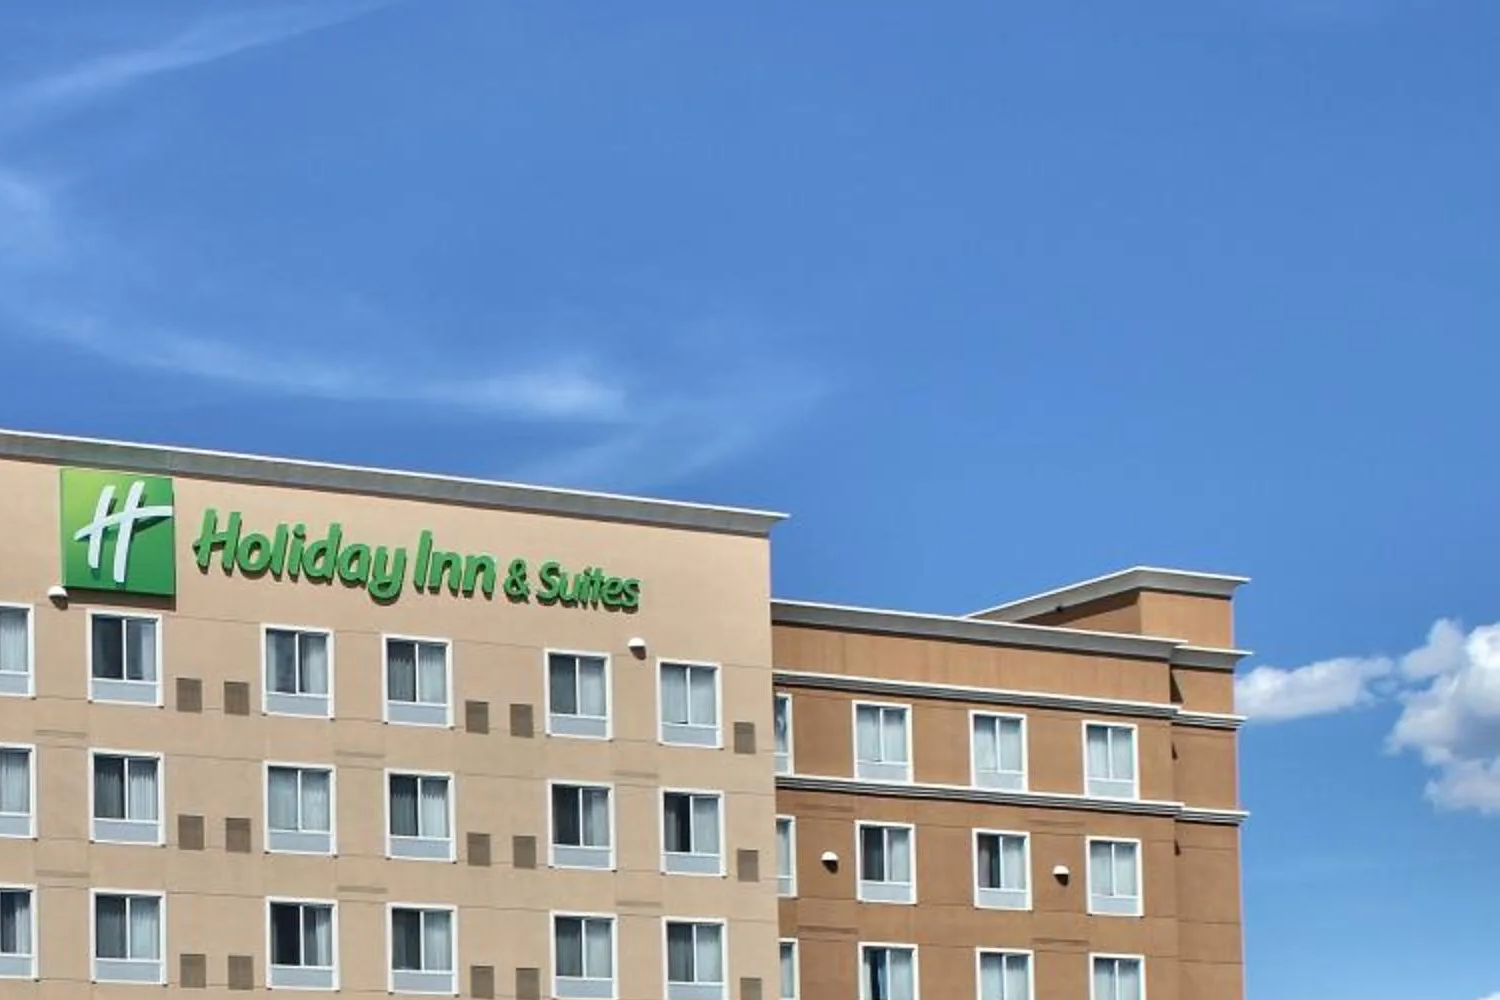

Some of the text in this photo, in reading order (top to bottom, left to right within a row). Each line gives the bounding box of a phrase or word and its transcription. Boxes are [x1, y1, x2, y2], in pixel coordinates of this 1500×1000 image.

[194, 509, 640, 609] Holiday Inn & Suites
